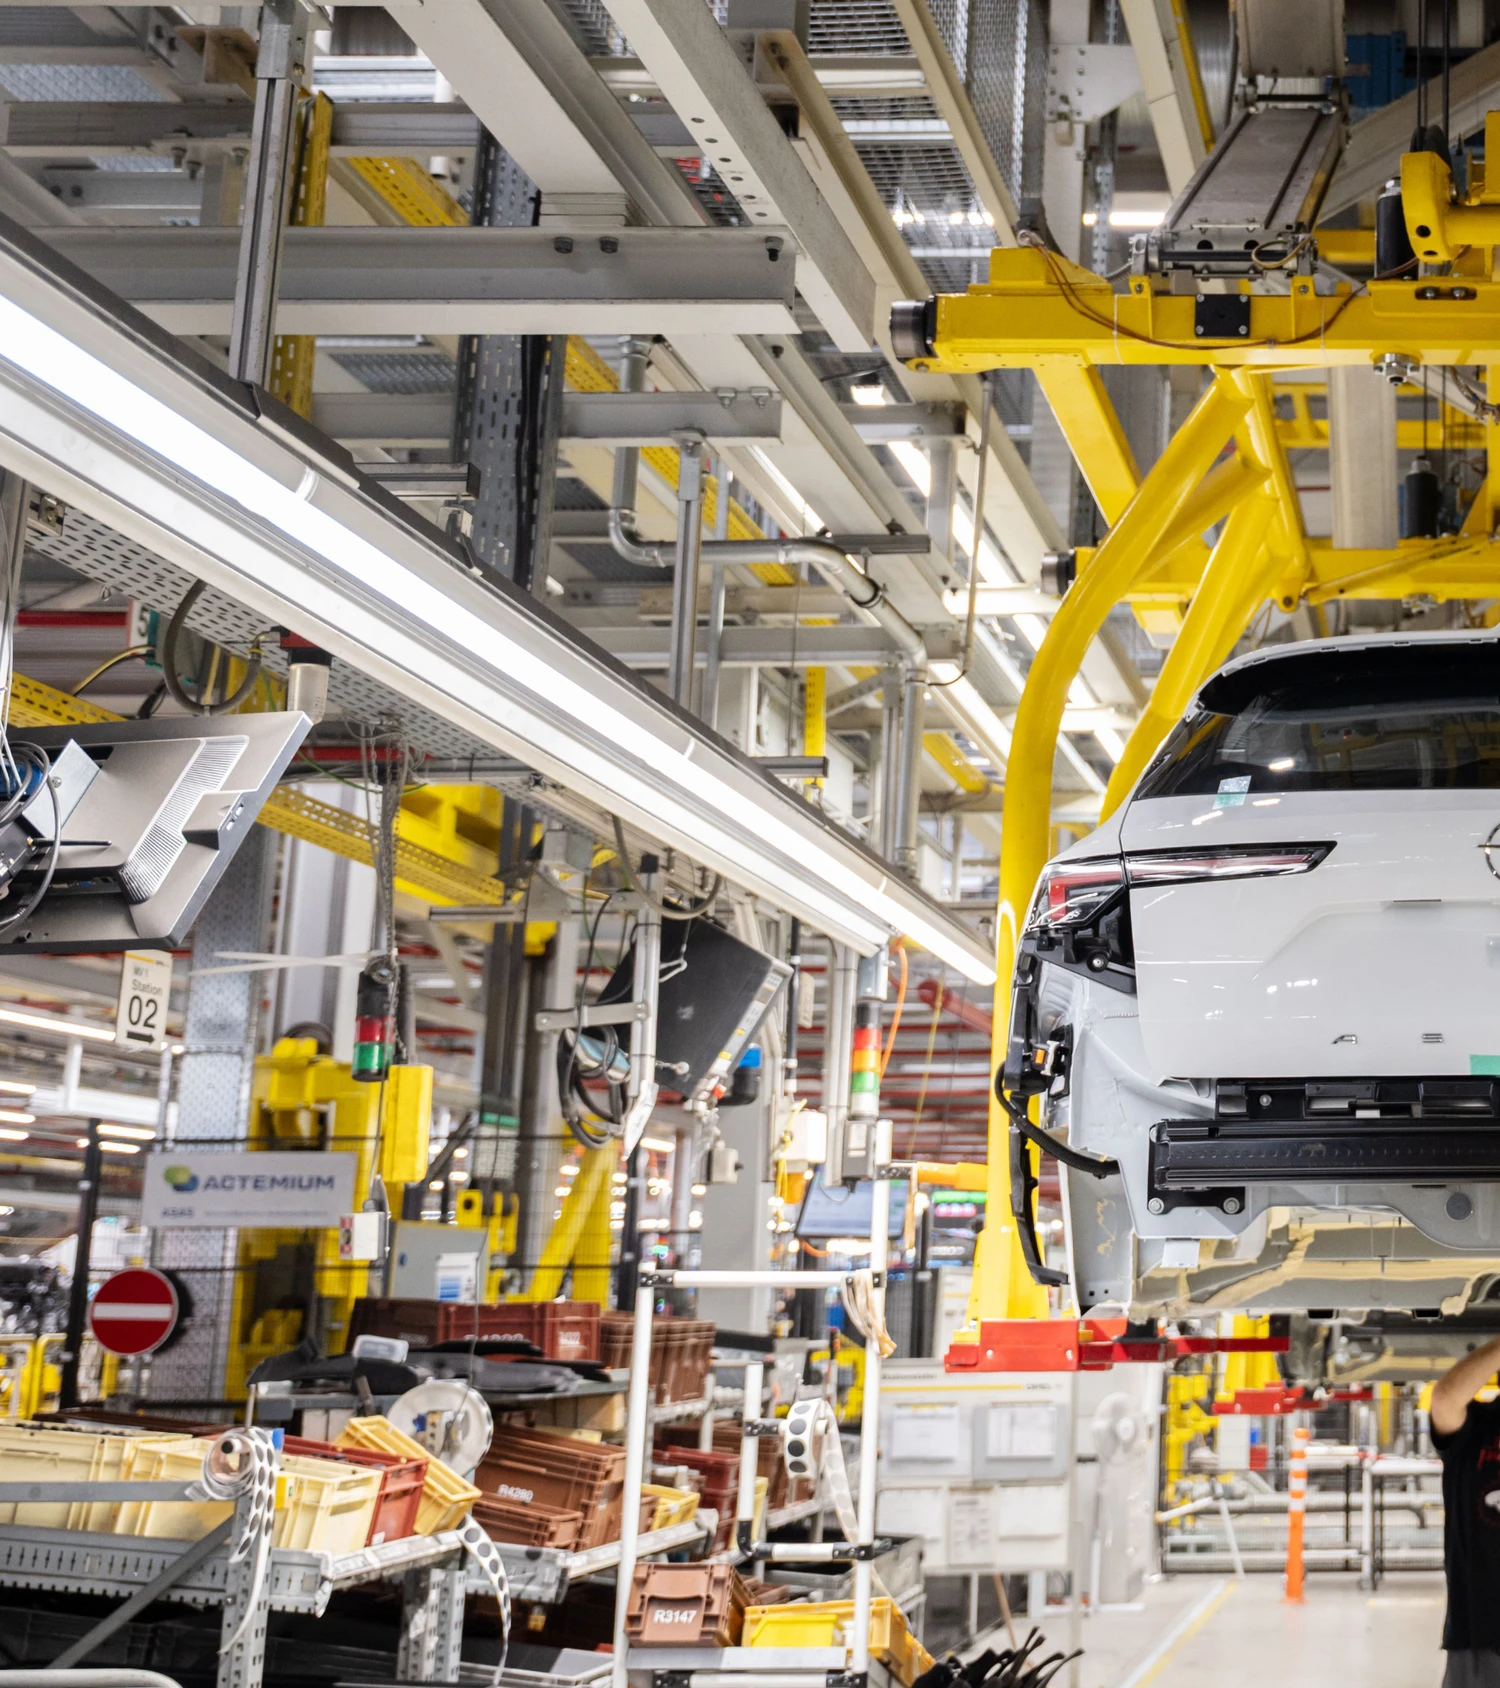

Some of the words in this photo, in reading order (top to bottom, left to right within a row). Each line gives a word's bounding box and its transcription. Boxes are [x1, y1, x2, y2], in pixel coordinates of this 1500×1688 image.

[131, 979, 164, 997] Station
[128, 994, 159, 1030] 02
[203, 1173, 336, 1192] ACTEMIUM
[653, 1609, 697, 1624] R3147
